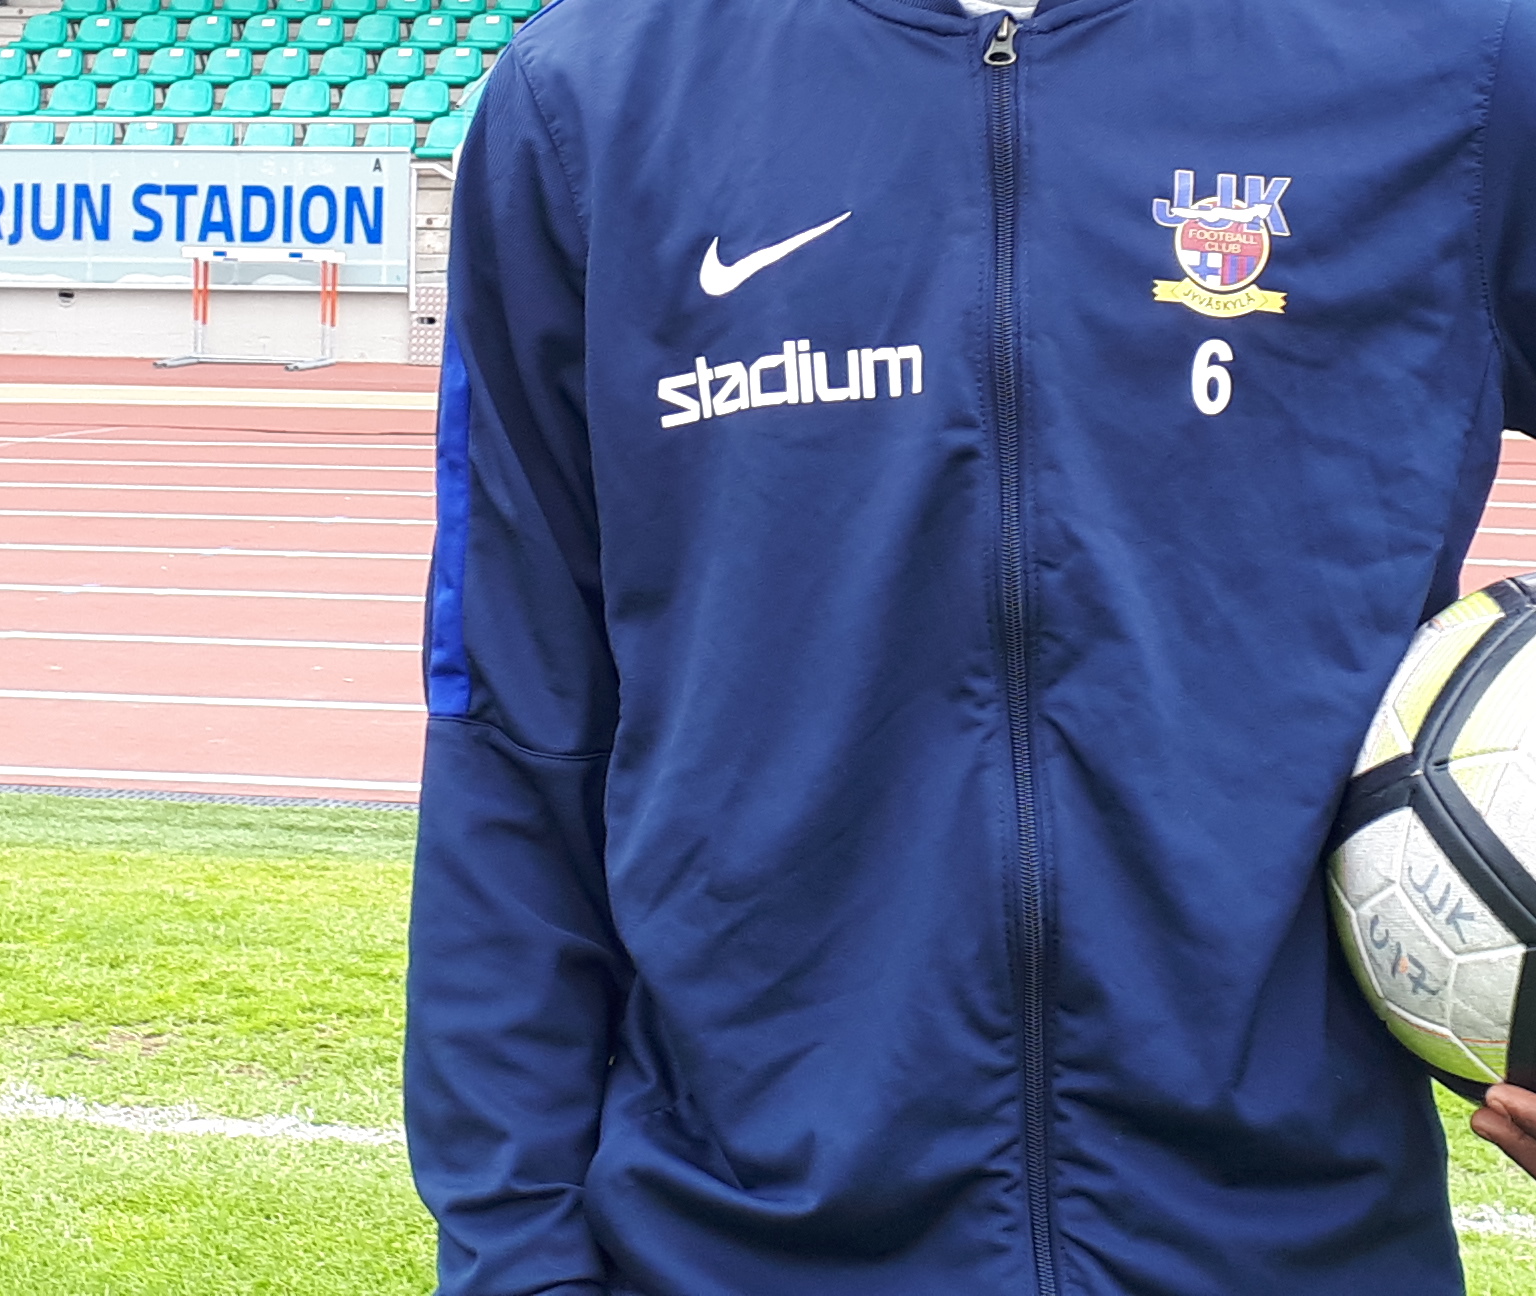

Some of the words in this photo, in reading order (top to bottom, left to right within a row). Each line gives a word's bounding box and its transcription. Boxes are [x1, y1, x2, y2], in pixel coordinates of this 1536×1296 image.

[372, 158, 383, 172] A
[132, 183, 383, 244] STADION
[1188, 229, 1258, 244] FOOTBALL
[1205, 241, 1242, 253] CLUB
[658, 339, 922, 428] stadium
[1192, 339, 1233, 415] 6
